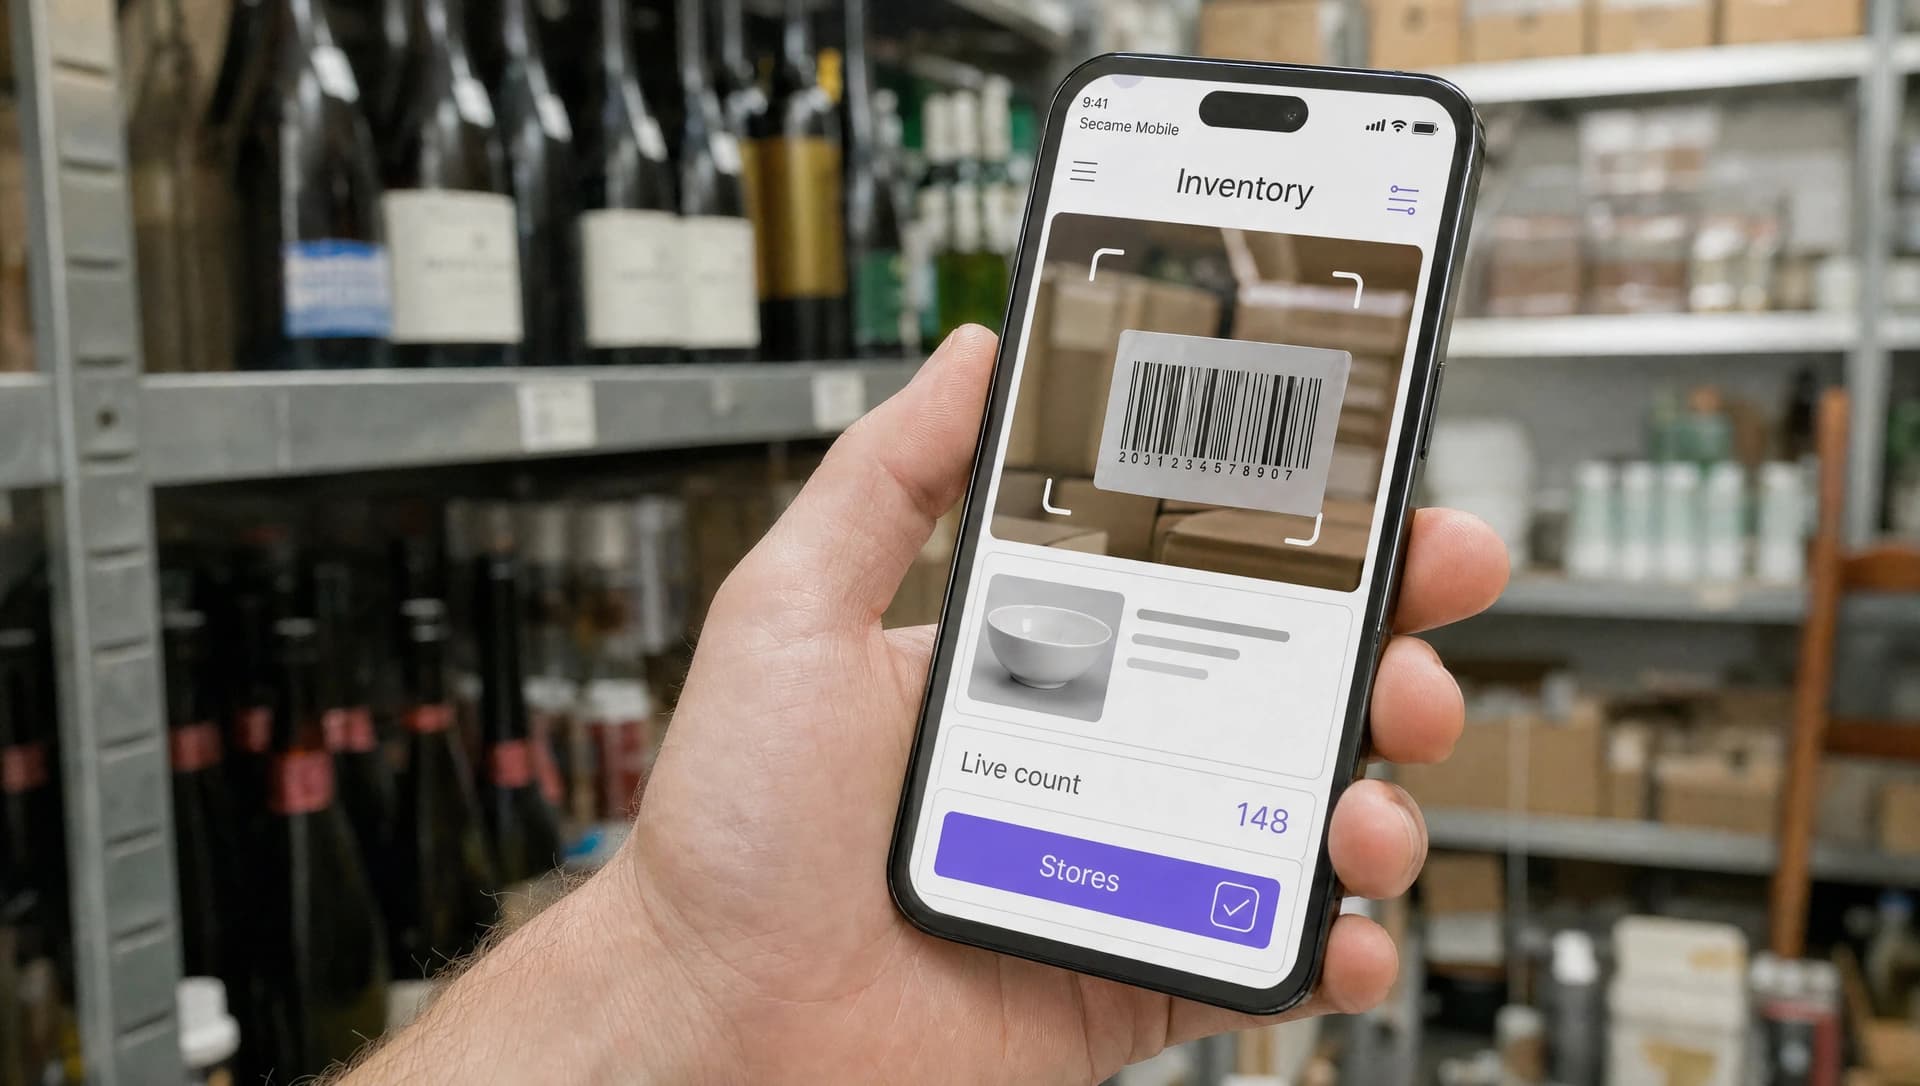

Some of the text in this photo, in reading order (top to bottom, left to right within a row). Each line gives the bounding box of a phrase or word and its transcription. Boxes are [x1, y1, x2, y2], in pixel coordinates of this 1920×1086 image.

[1082, 96, 1109, 110] 9:41
[1079, 116, 1180, 137] Secame Mobile
[1176, 167, 1315, 211] Inventory
[960, 751, 1082, 796] Live count
[1237, 802, 1289, 834] 148
[1039, 854, 1121, 893] Stores
